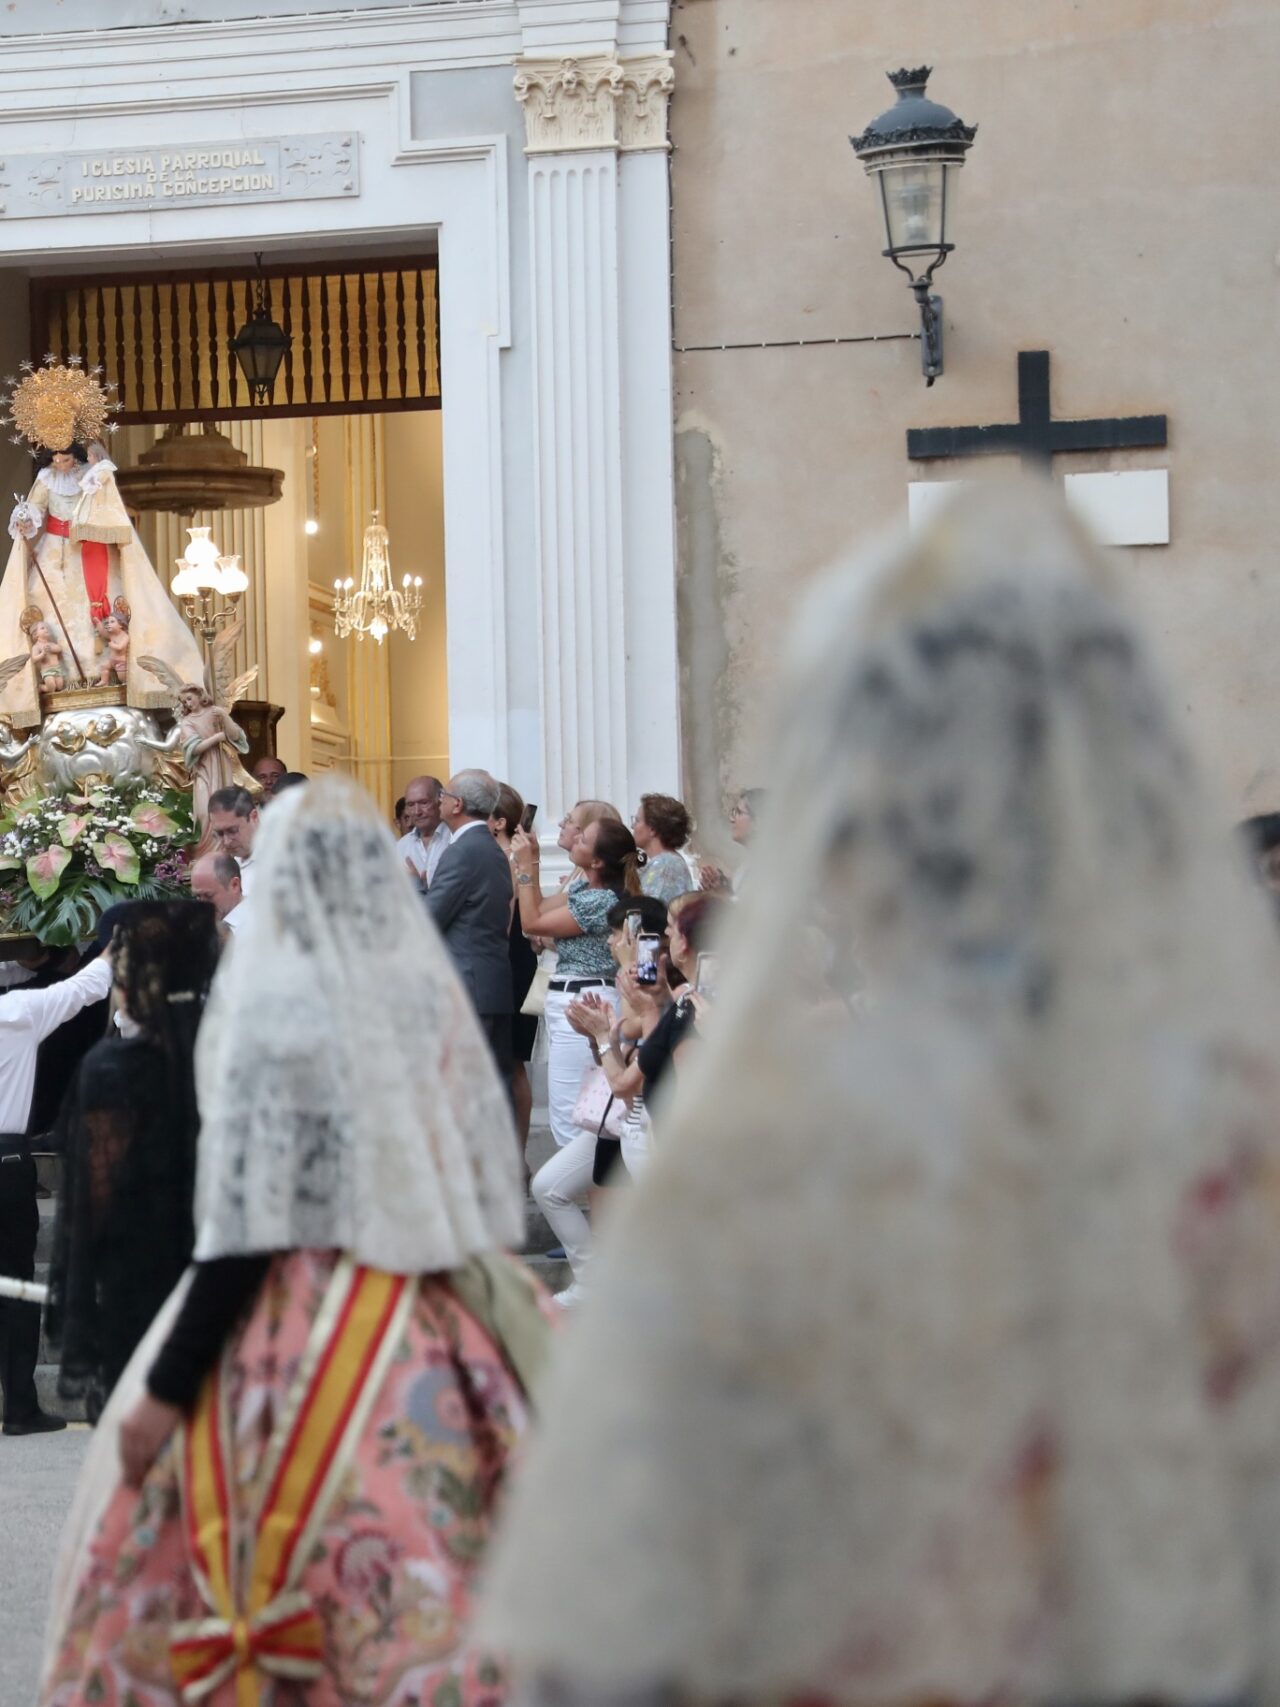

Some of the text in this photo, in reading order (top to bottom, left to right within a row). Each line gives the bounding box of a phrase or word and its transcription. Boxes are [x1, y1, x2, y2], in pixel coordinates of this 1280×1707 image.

[146, 170, 195, 184] DE LA
[71, 174, 274, 204] PURISIMA CONCEPCION
